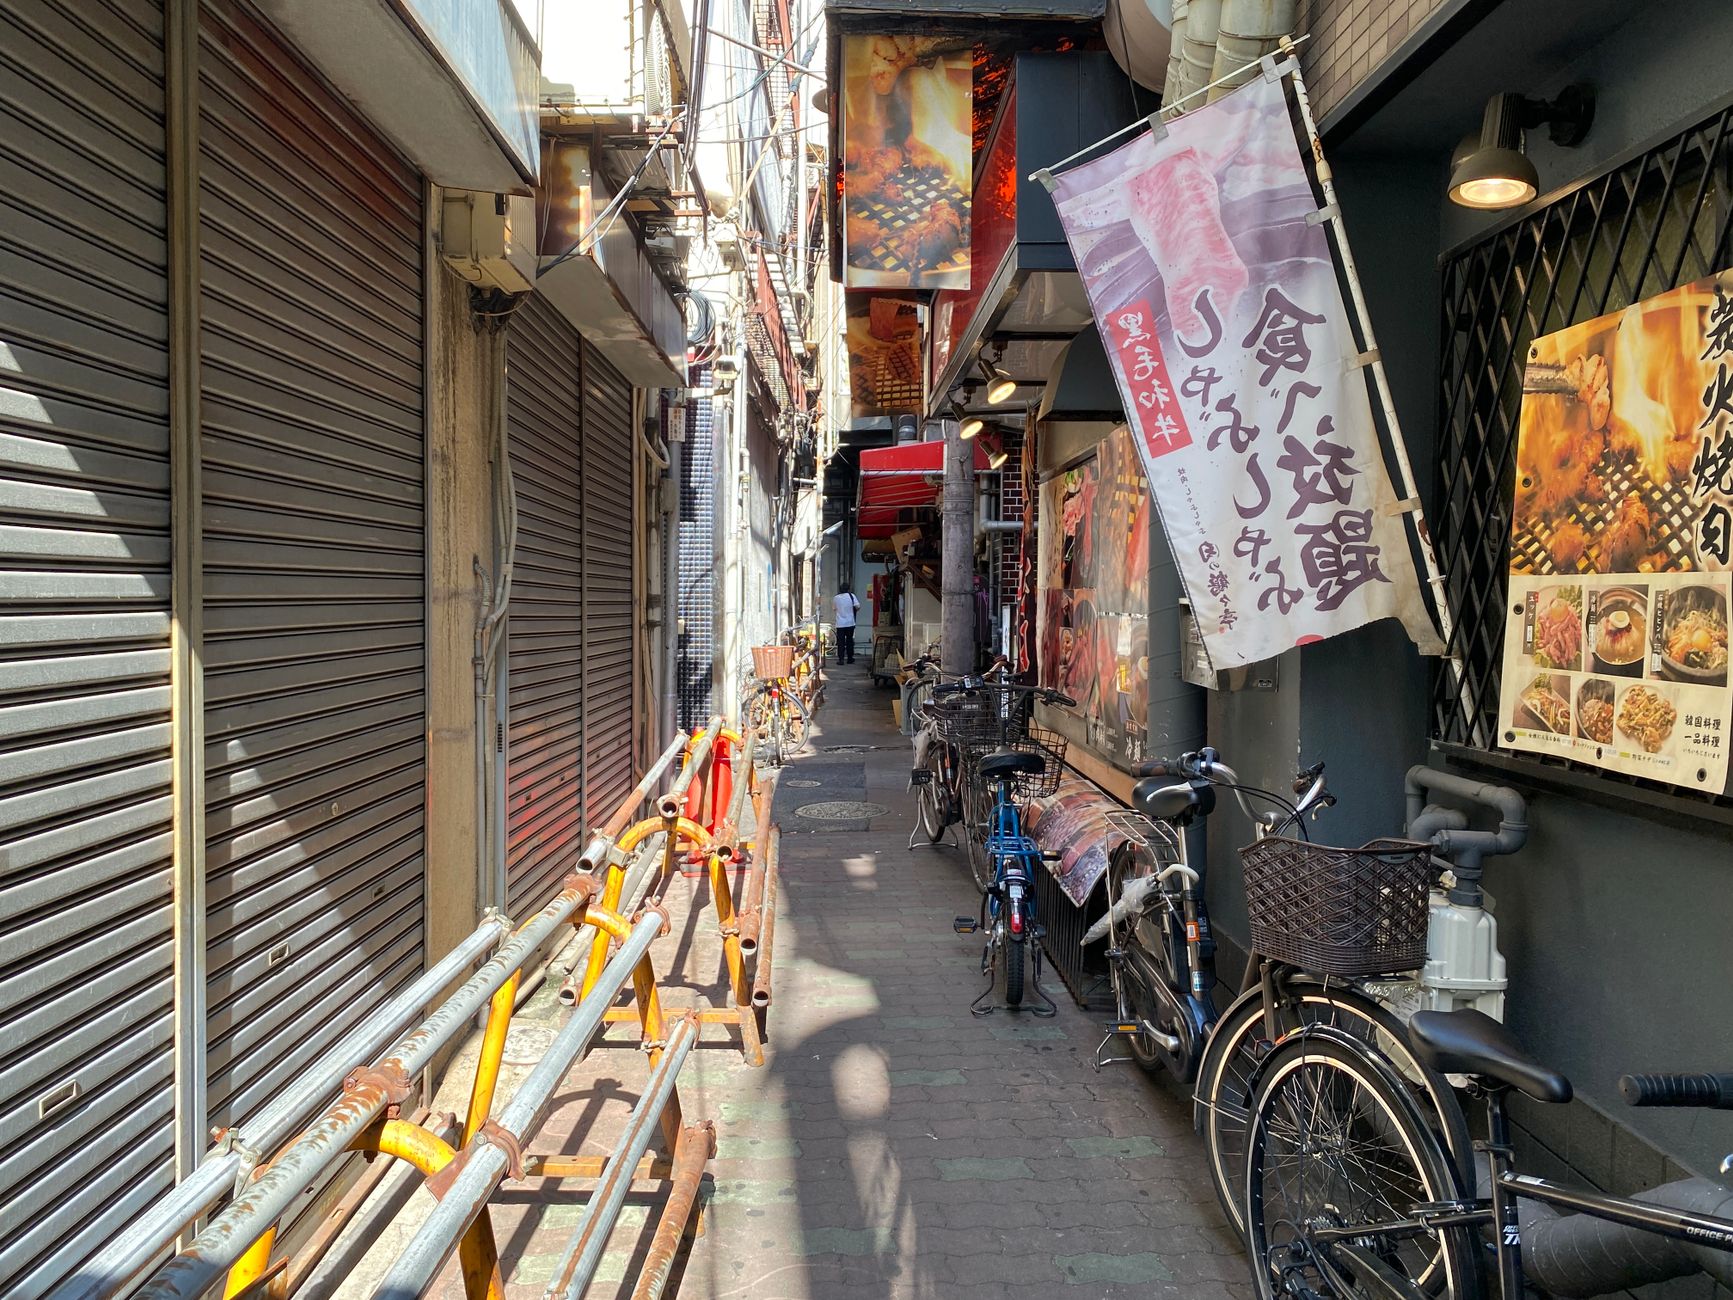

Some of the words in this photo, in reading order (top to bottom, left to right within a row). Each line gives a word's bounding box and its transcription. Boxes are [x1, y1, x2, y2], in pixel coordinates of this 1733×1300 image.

[1684, 714, 1722, 731] 韓国料理
[1684, 733, 1721, 748] 一品料理
[1686, 1226, 1725, 1241] OFFICE
